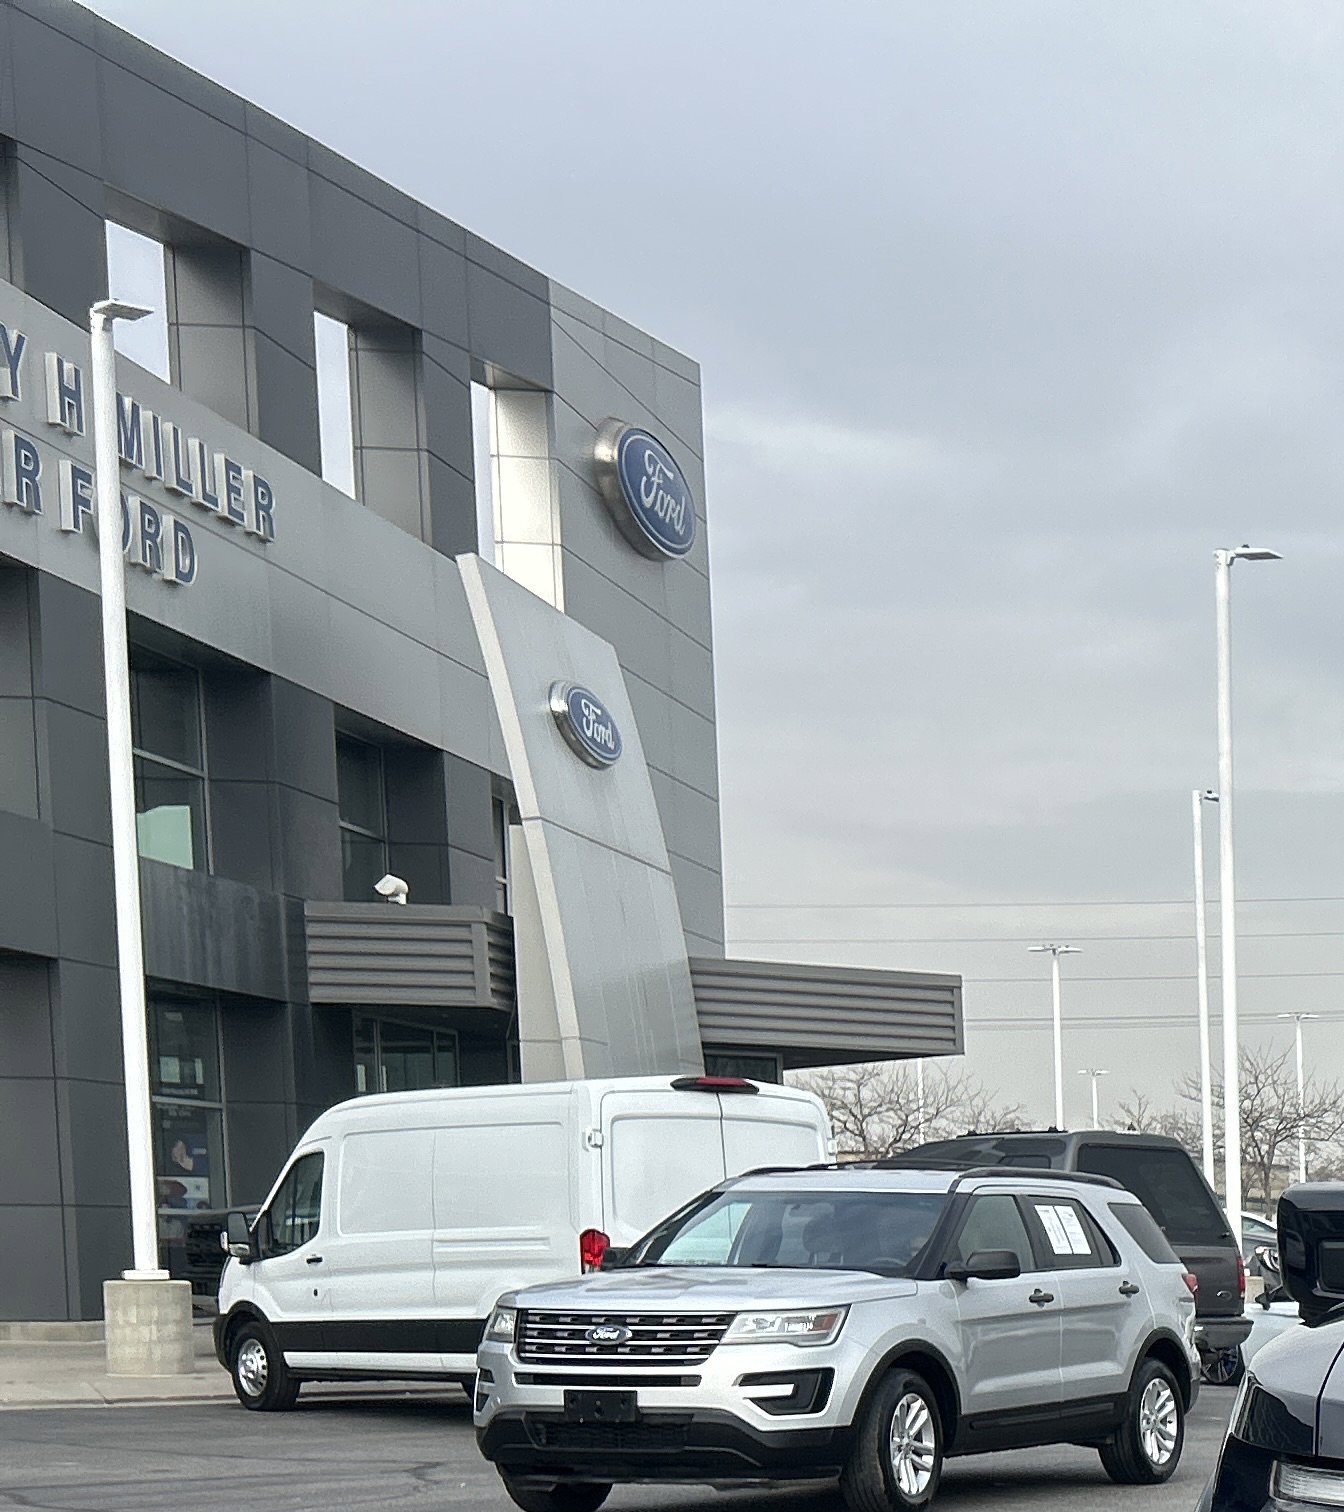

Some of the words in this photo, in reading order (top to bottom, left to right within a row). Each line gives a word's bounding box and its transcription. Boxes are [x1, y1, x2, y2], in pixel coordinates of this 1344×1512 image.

[0, 320, 27, 401] Y
[45, 351, 86, 436] H
[116, 390, 276, 542] MILLER
[1, 428, 43, 515] R
[639, 449, 687, 536] Ford
[580, 698, 616, 751] Ford
[592, 1327, 620, 1340] Ford
